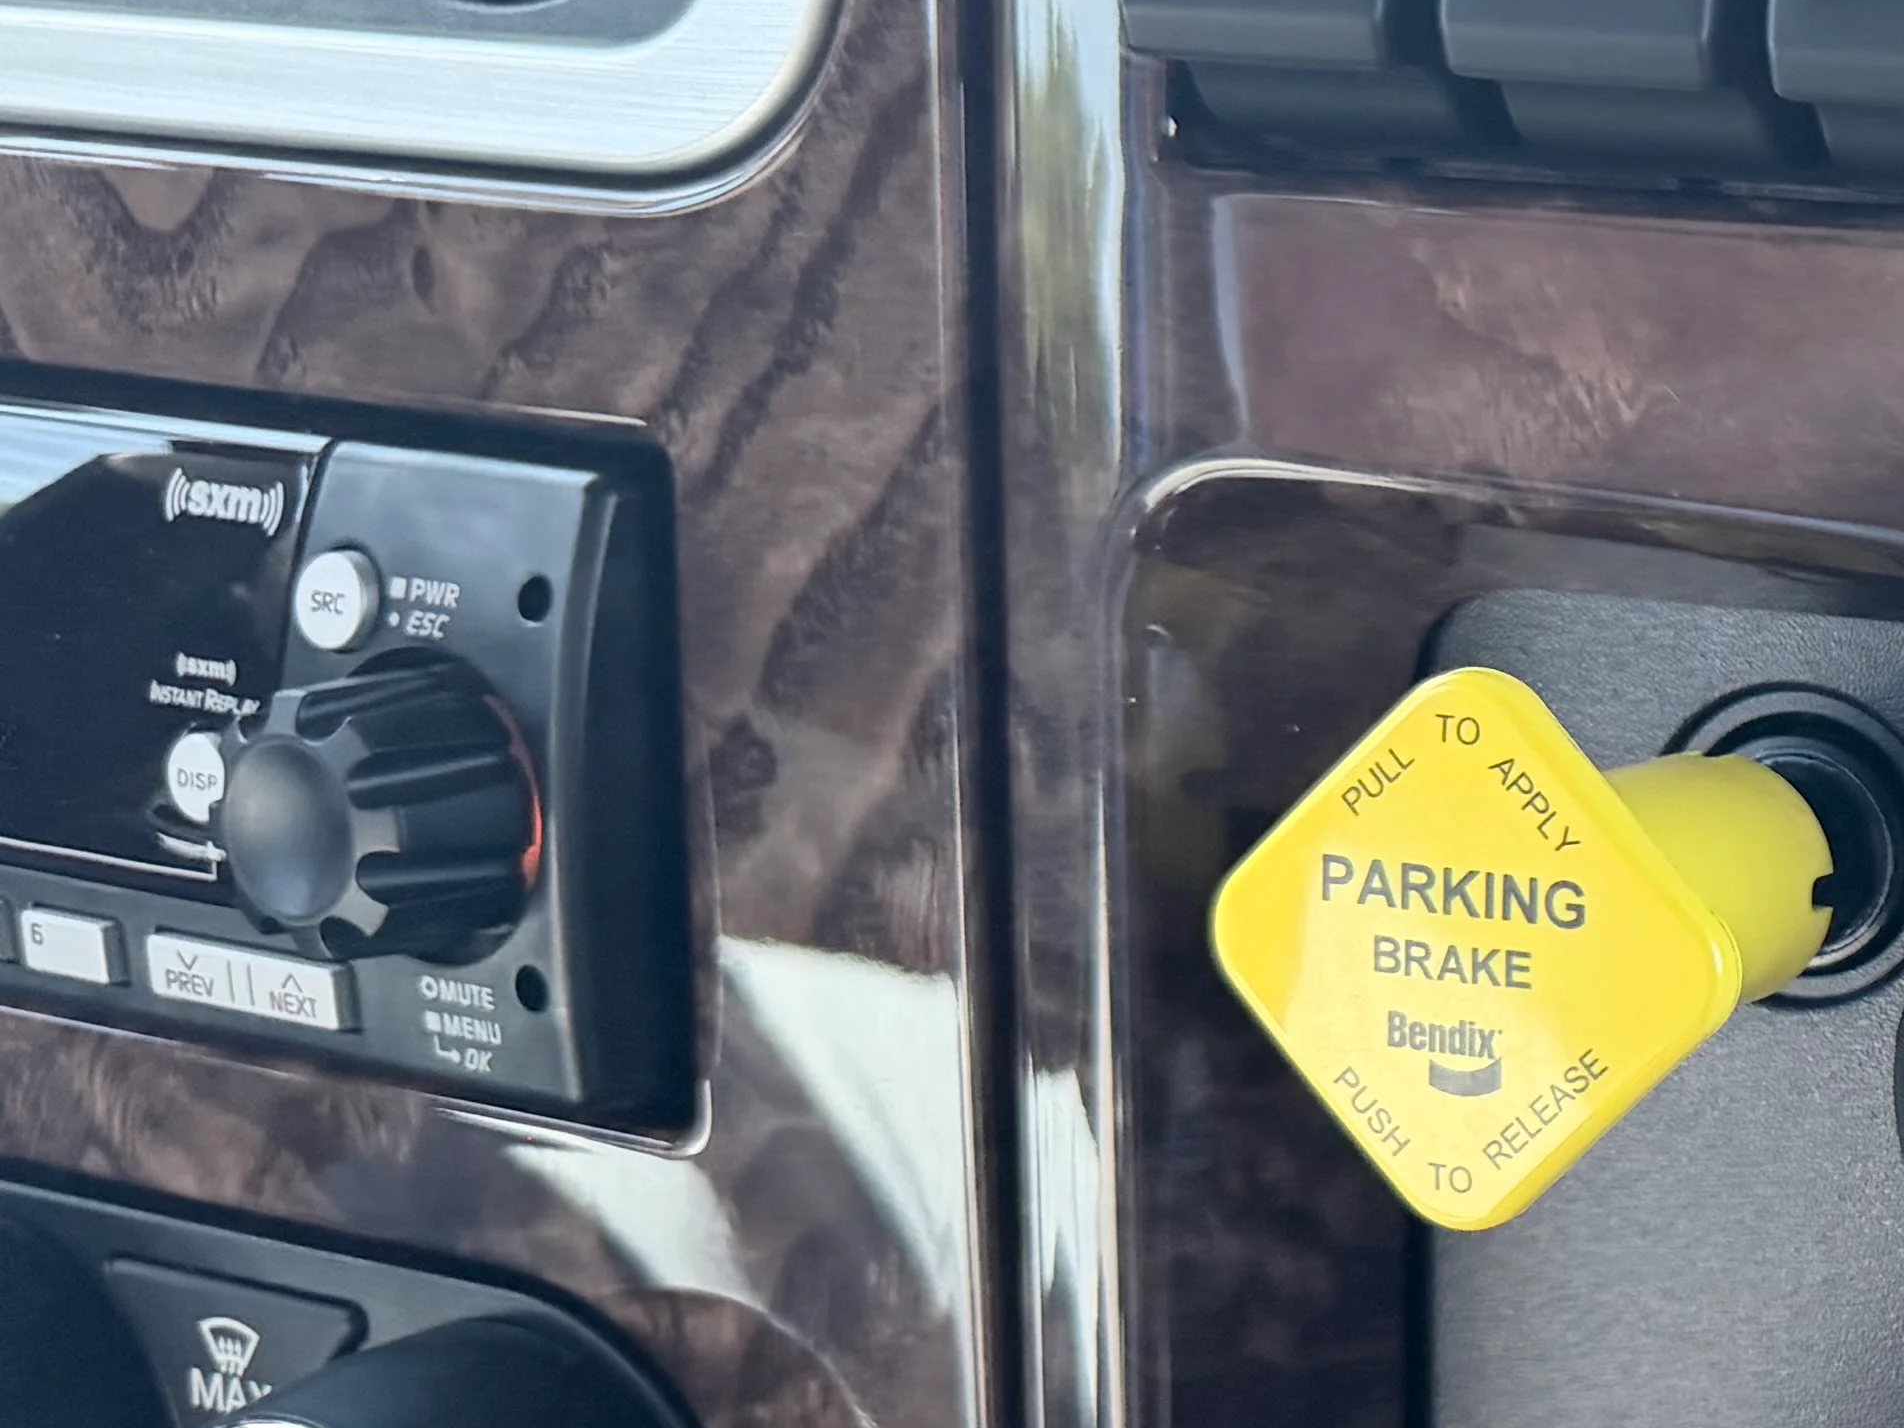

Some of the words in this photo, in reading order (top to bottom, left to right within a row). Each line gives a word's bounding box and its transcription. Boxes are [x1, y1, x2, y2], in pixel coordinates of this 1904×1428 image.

[310, 590, 346, 616] SRC
[409, 577, 462, 609] PWR
[405, 610, 452, 640] ESC
[176, 767, 218, 791] DISP
[1340, 748, 1416, 817] PULL
[1434, 712, 1482, 746] TO
[1488, 756, 1583, 854] APPLY
[1320, 853, 1588, 930] PARKING
[30, 925, 44, 948] 6
[1372, 934, 1534, 990] BRAKE
[164, 969, 215, 999] PREV
[439, 980, 495, 1012] MUTE
[269, 989, 318, 1020] NEXT
[441, 1012, 501, 1045] MENU
[1387, 1009, 1496, 1060] Bendix
[463, 1049, 493, 1073] OK
[1332, 1064, 1412, 1157] PUSH
[1426, 1161, 1475, 1195] TO
[1481, 1048, 1610, 1170] RELEASE
